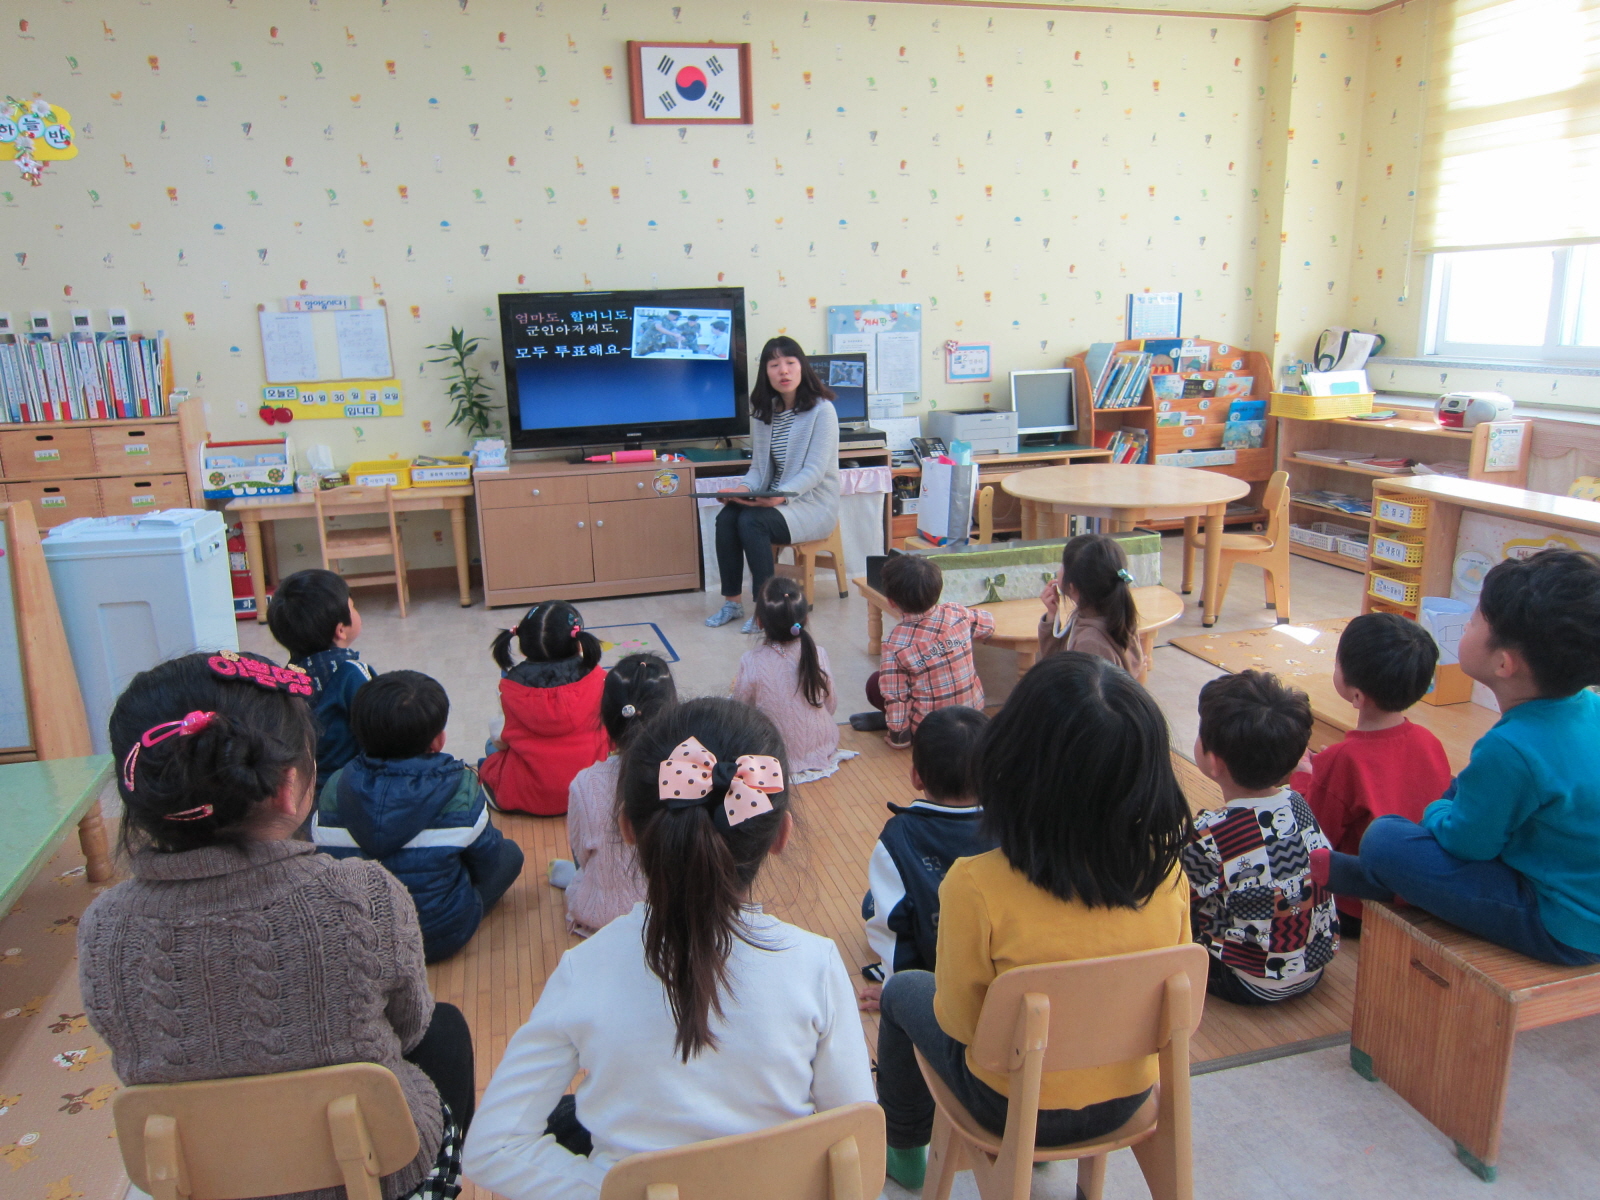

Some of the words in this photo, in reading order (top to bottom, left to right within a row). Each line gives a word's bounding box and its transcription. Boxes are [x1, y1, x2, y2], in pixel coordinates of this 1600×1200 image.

[515, 312, 565, 325] 엄마도,
[569, 309, 632, 323] 할머니도,
[525, 323, 619, 336] 군인아저씨도,
[515, 345, 548, 358] 모두
[267, 388, 295, 398] 오늘은
[347, 407, 375, 416] 입니다
